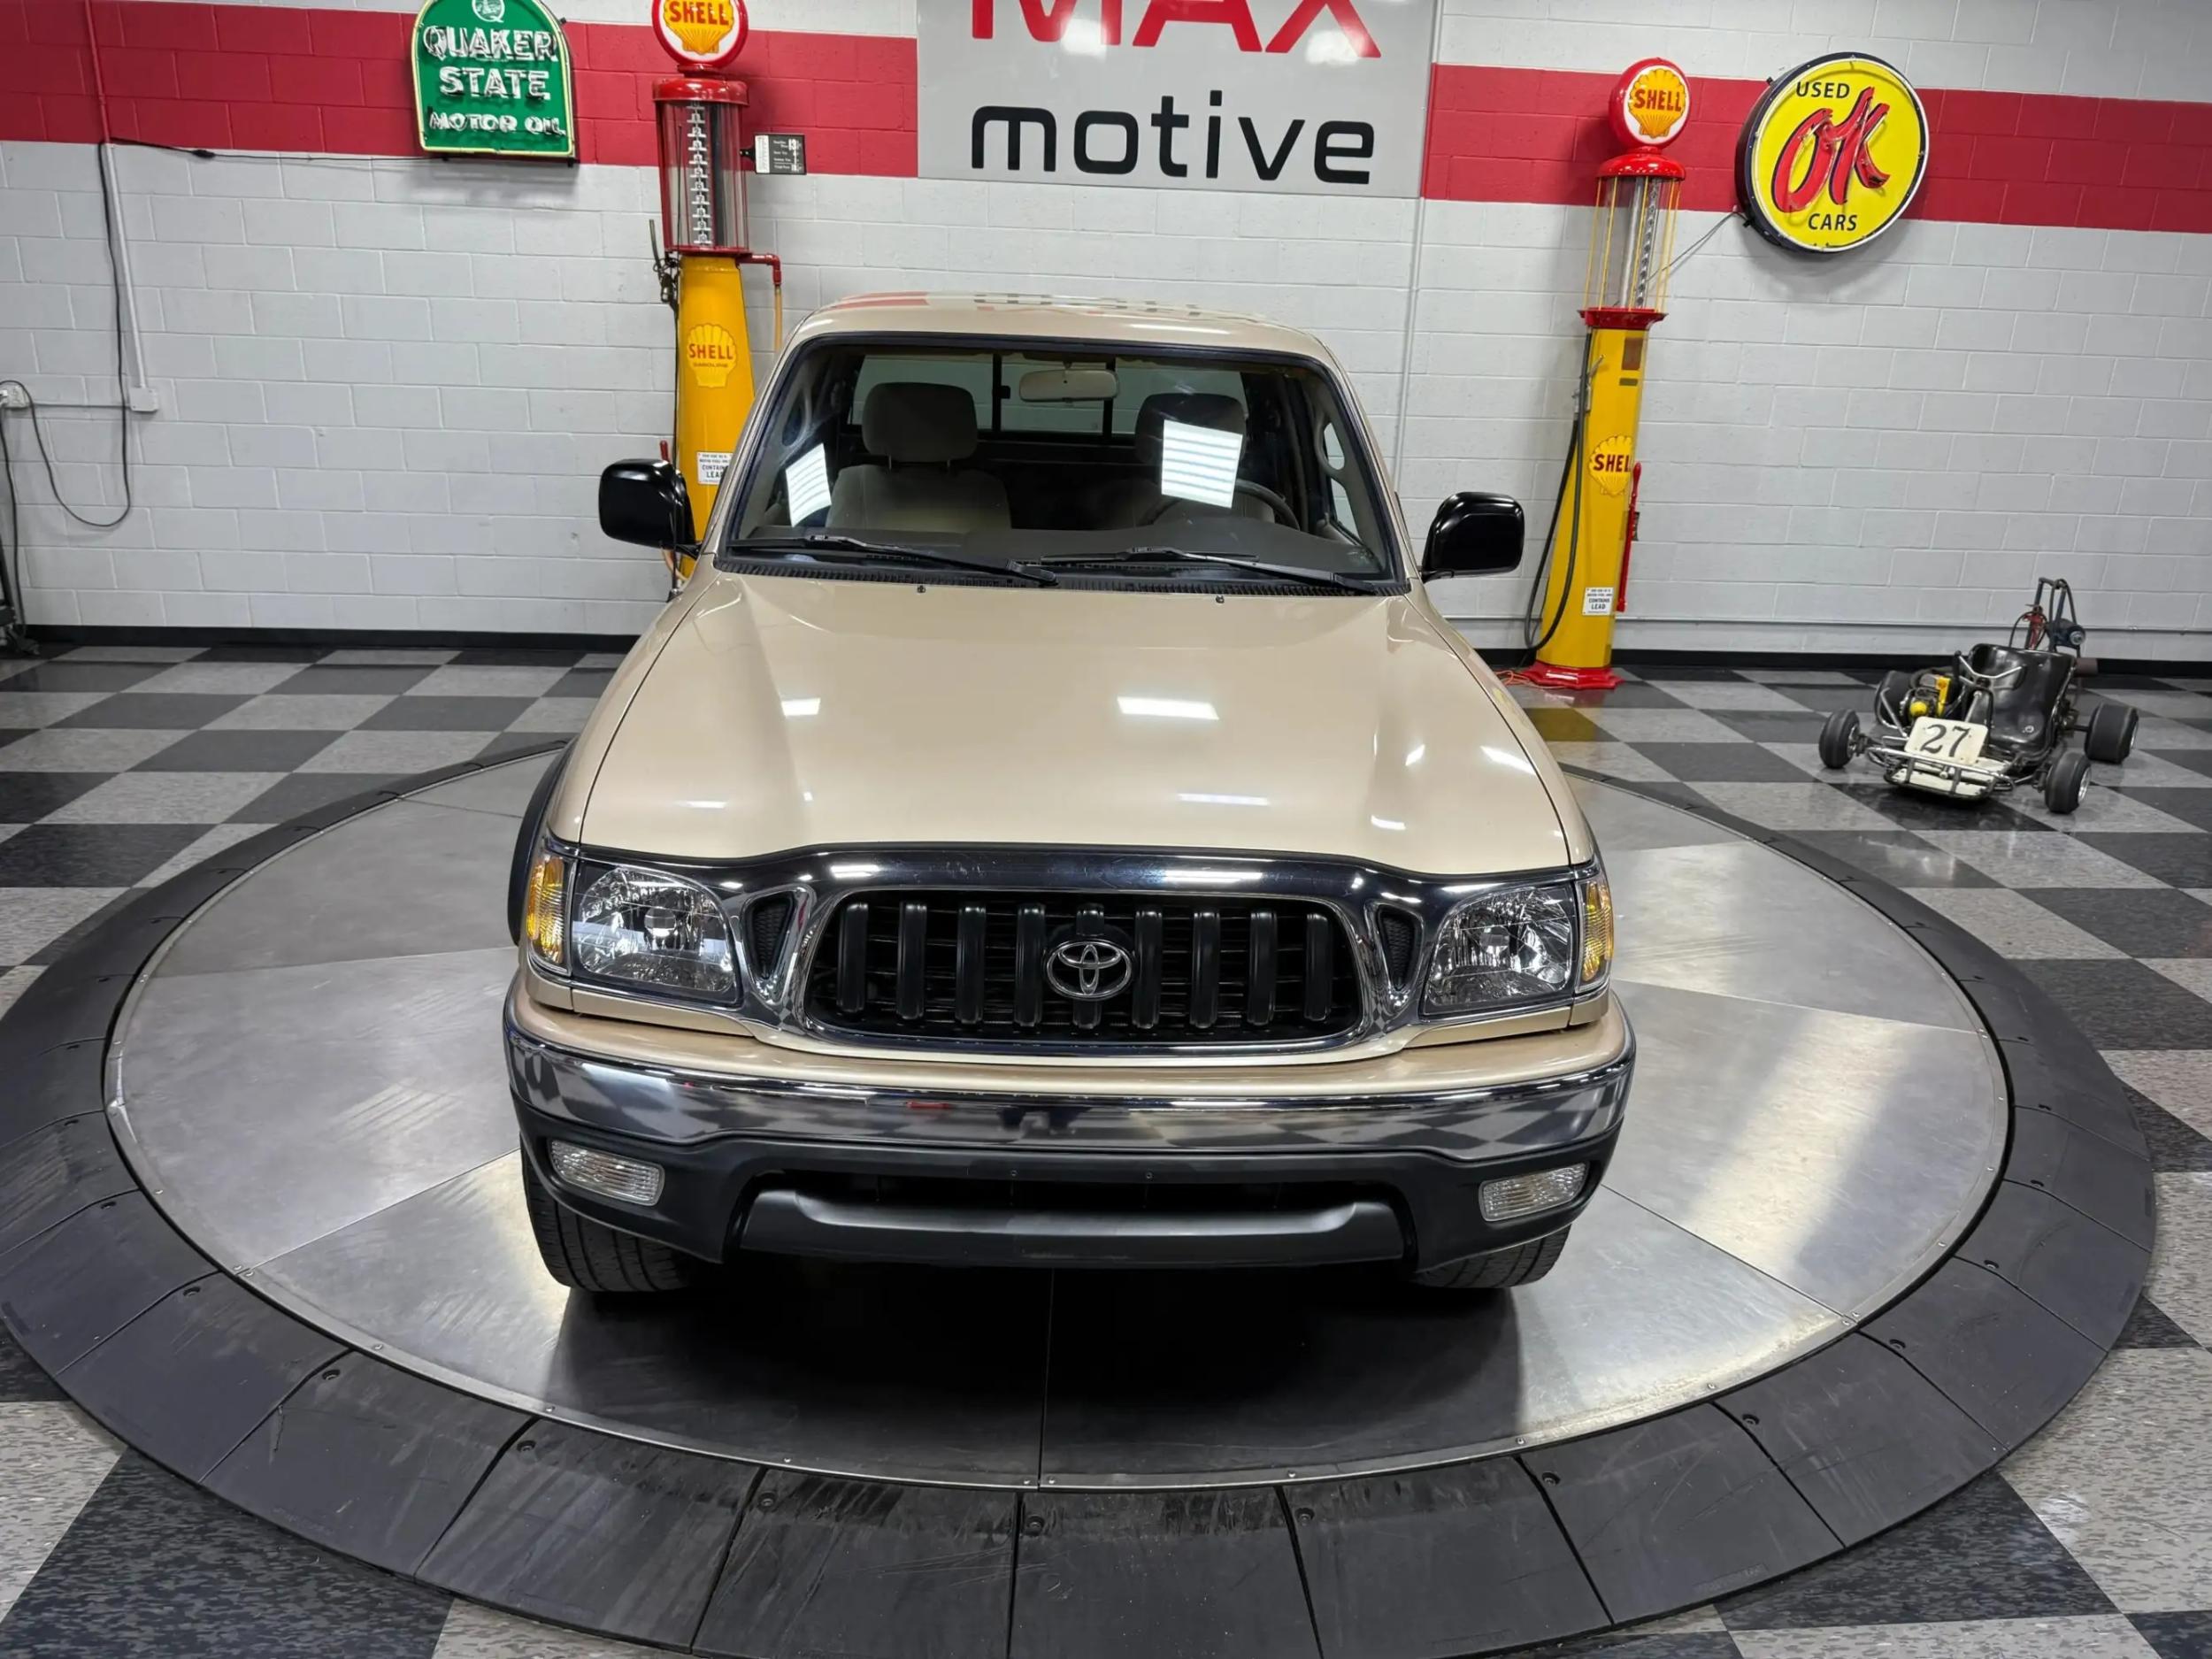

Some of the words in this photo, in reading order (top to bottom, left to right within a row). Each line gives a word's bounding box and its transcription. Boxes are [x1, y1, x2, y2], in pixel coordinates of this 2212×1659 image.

[669, 1, 729, 26] SHELL
[423, 26, 558, 62] QUAKER
[439, 66, 551, 100] STATE
[1795, 81, 1850, 98] USED
[1633, 88, 1682, 111] SHELL
[429, 111, 518, 132] MOTOR
[525, 117, 566, 135] OIL
[972, 90, 1375, 184] motive
[1809, 213, 1858, 231] CARS
[689, 343, 733, 359] SHELL
[1920, 724, 1971, 757] 27
